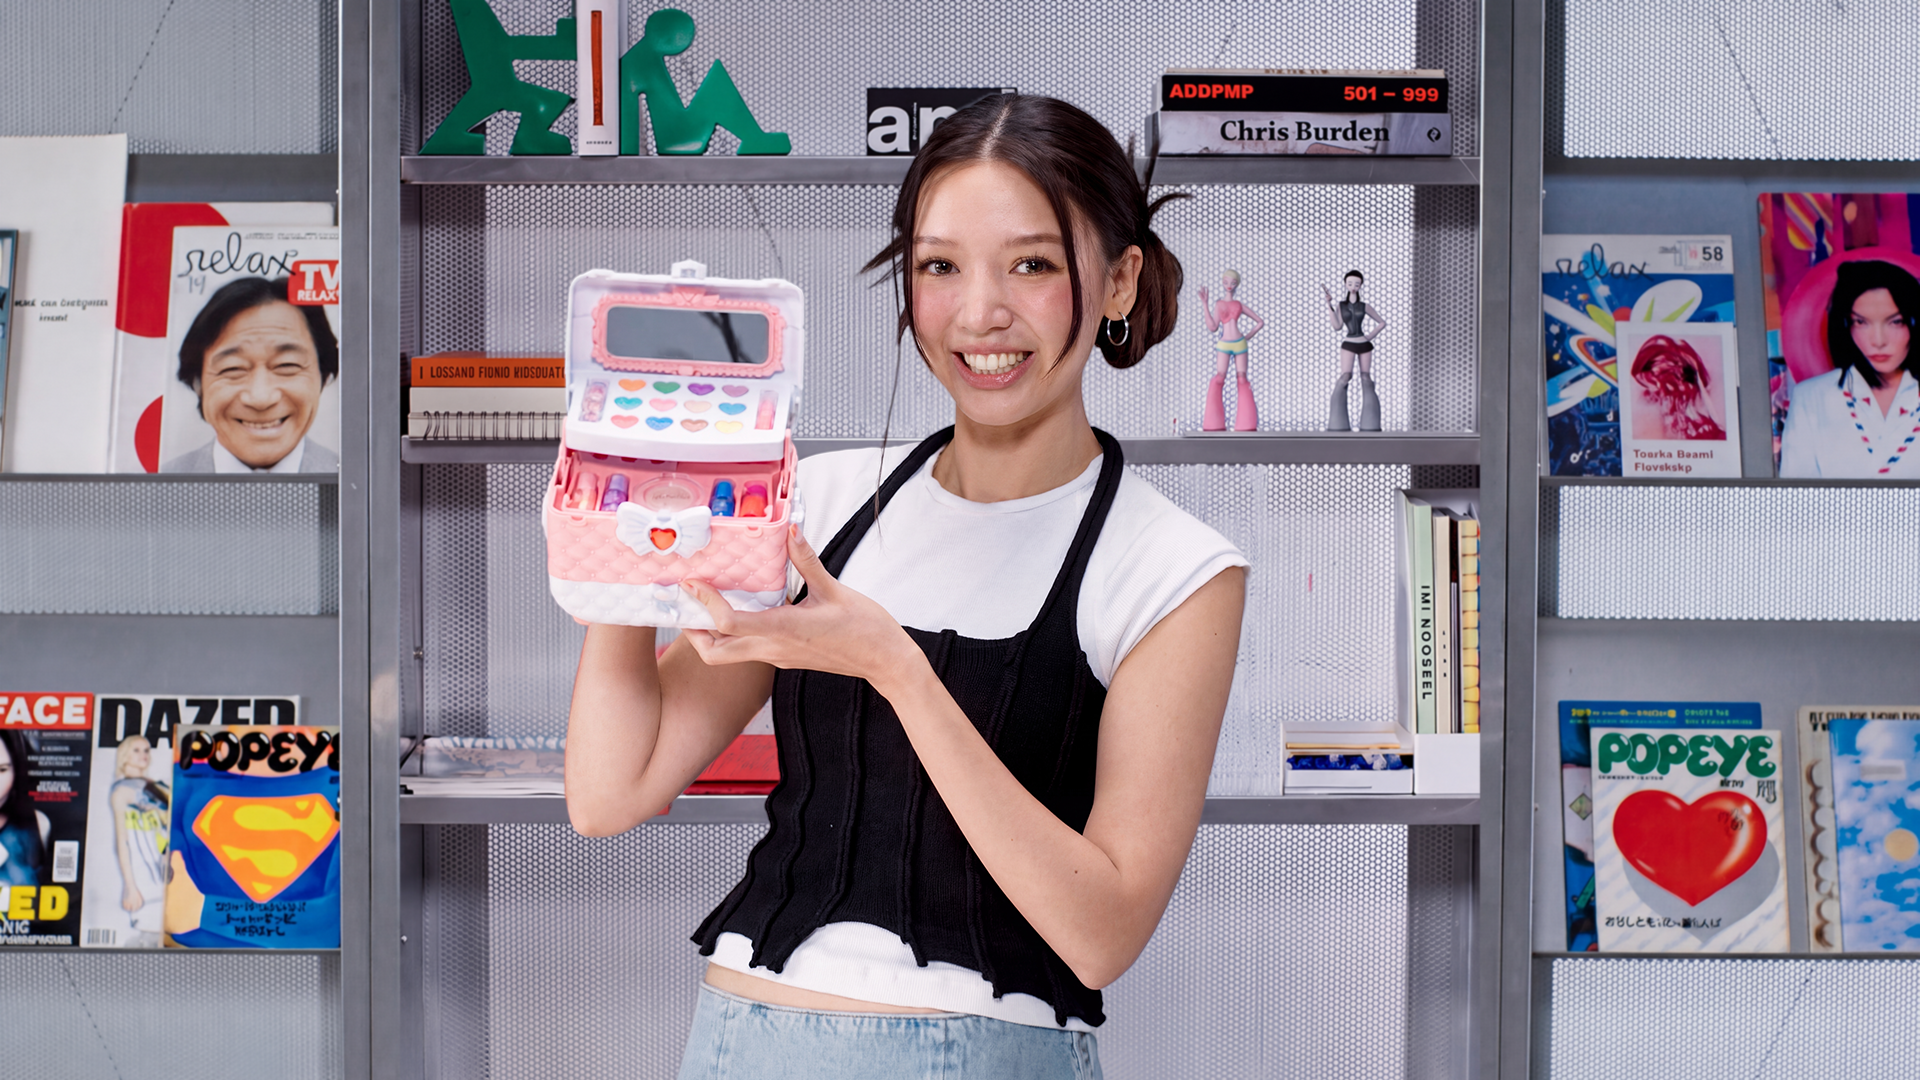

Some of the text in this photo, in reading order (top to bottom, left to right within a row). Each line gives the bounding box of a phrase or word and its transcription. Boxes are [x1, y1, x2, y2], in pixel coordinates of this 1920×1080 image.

[1169, 83, 1254, 99] ADDPMP
[1343, 86, 1377, 101] 501
[1402, 87, 1439, 102] 999
[1220, 120, 1390, 142] Chris Burden
[177, 232, 299, 276] relax
[1555, 242, 1655, 282] relax
[1702, 246, 1724, 261] 58
[300, 263, 339, 290] TV
[1598, 733, 1776, 778] POPEYE
